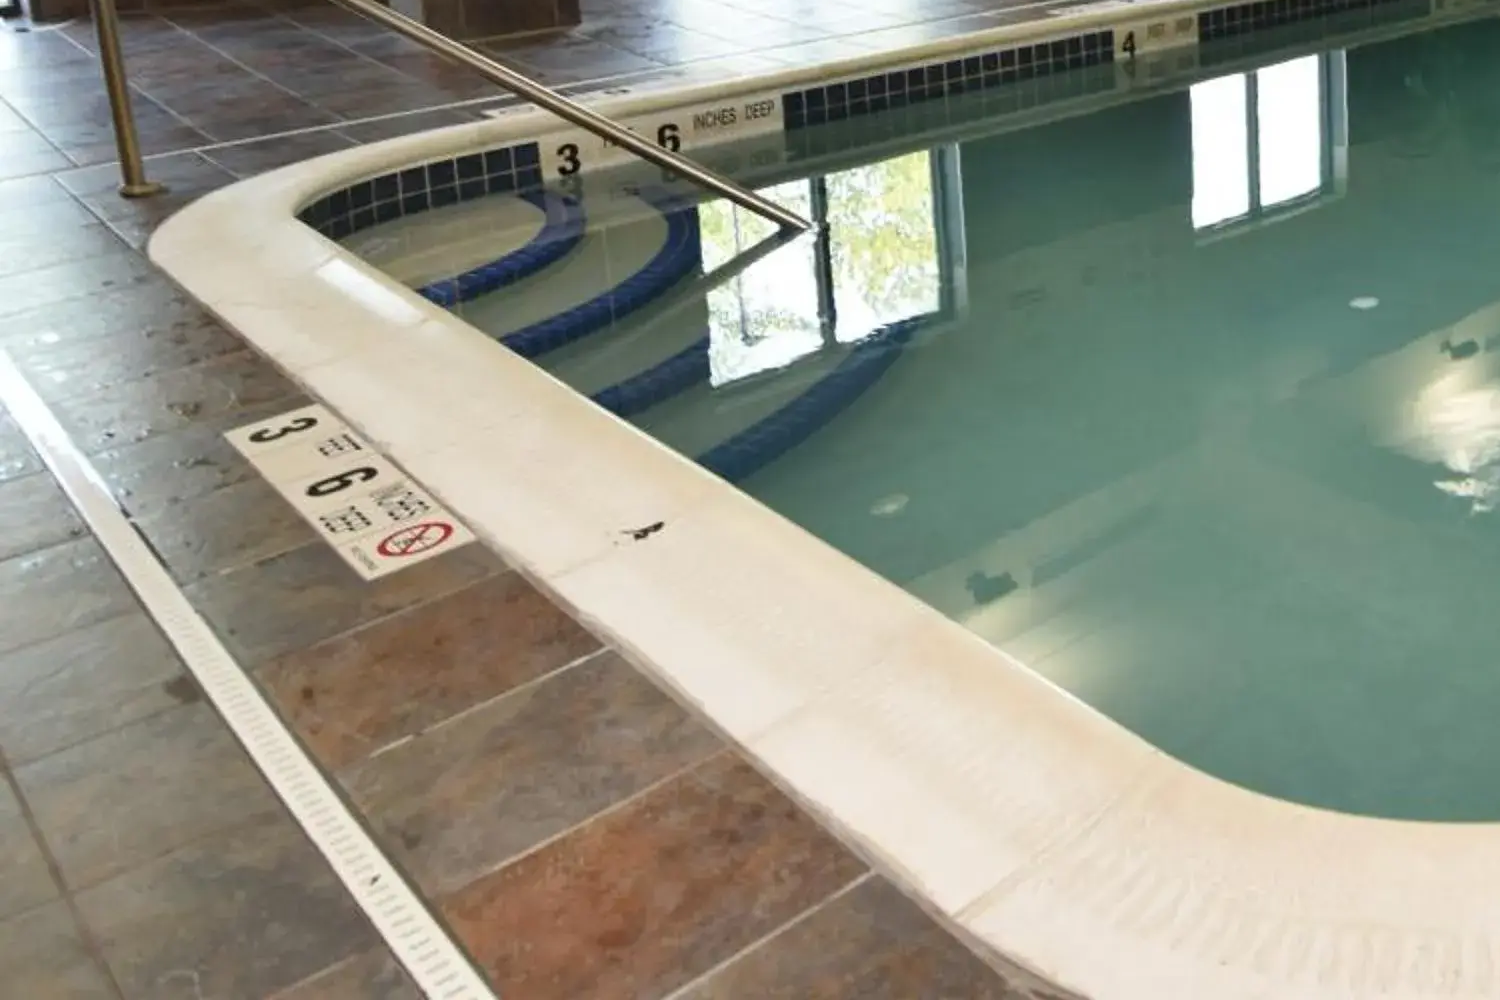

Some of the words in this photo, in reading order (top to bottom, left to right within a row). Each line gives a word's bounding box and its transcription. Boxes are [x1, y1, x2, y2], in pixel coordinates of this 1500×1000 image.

[1122, 30, 1136, 58] 4
[556, 143, 581, 176] 3
[657, 123, 681, 153] 6
[693, 107, 737, 131] INCHES
[744, 98, 776, 121] DEEP
[248, 416, 318, 444] 3
[305, 466, 379, 498] 6
